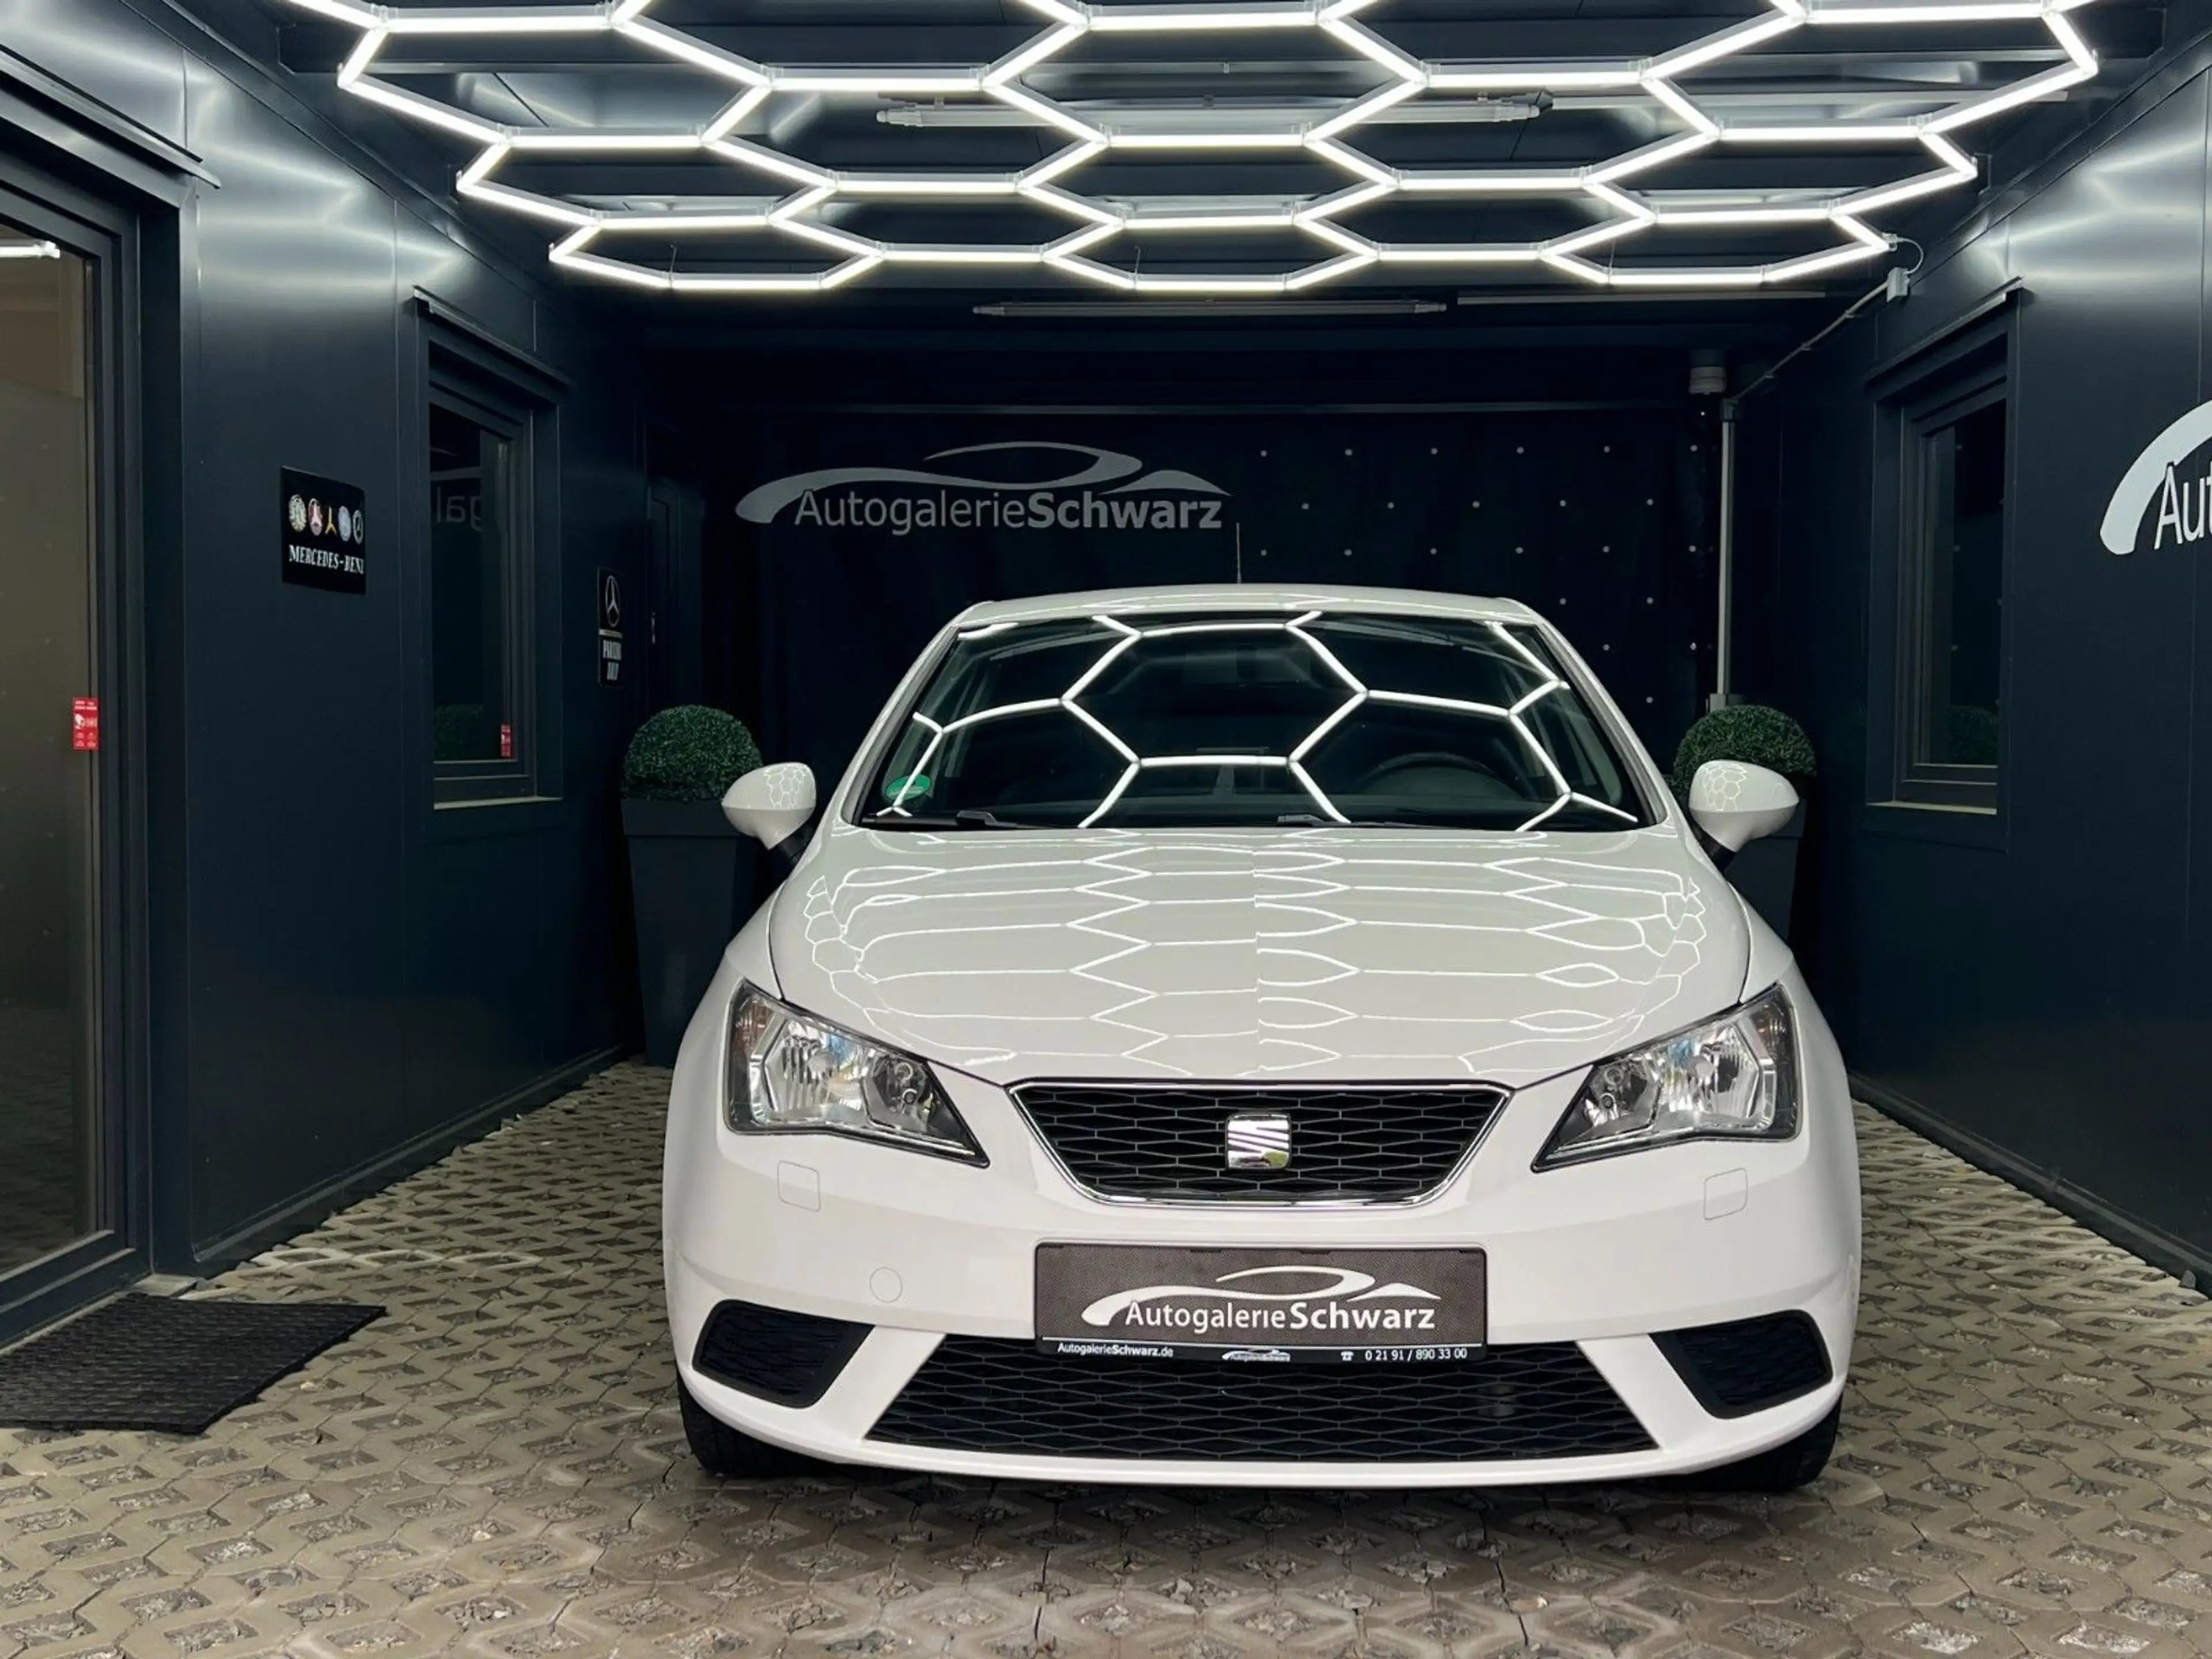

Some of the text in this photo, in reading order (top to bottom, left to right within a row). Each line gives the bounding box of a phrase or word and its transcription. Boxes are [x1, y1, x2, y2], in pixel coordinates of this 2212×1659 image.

[794, 490, 1222, 536] AutogalerieSchwarz
[1125, 1301, 1435, 1335] AutogalerieSchwarz
[1058, 1342, 1173, 1357] AutogalerieSchwarz.de
[1415, 1349, 1435, 1360] 890
